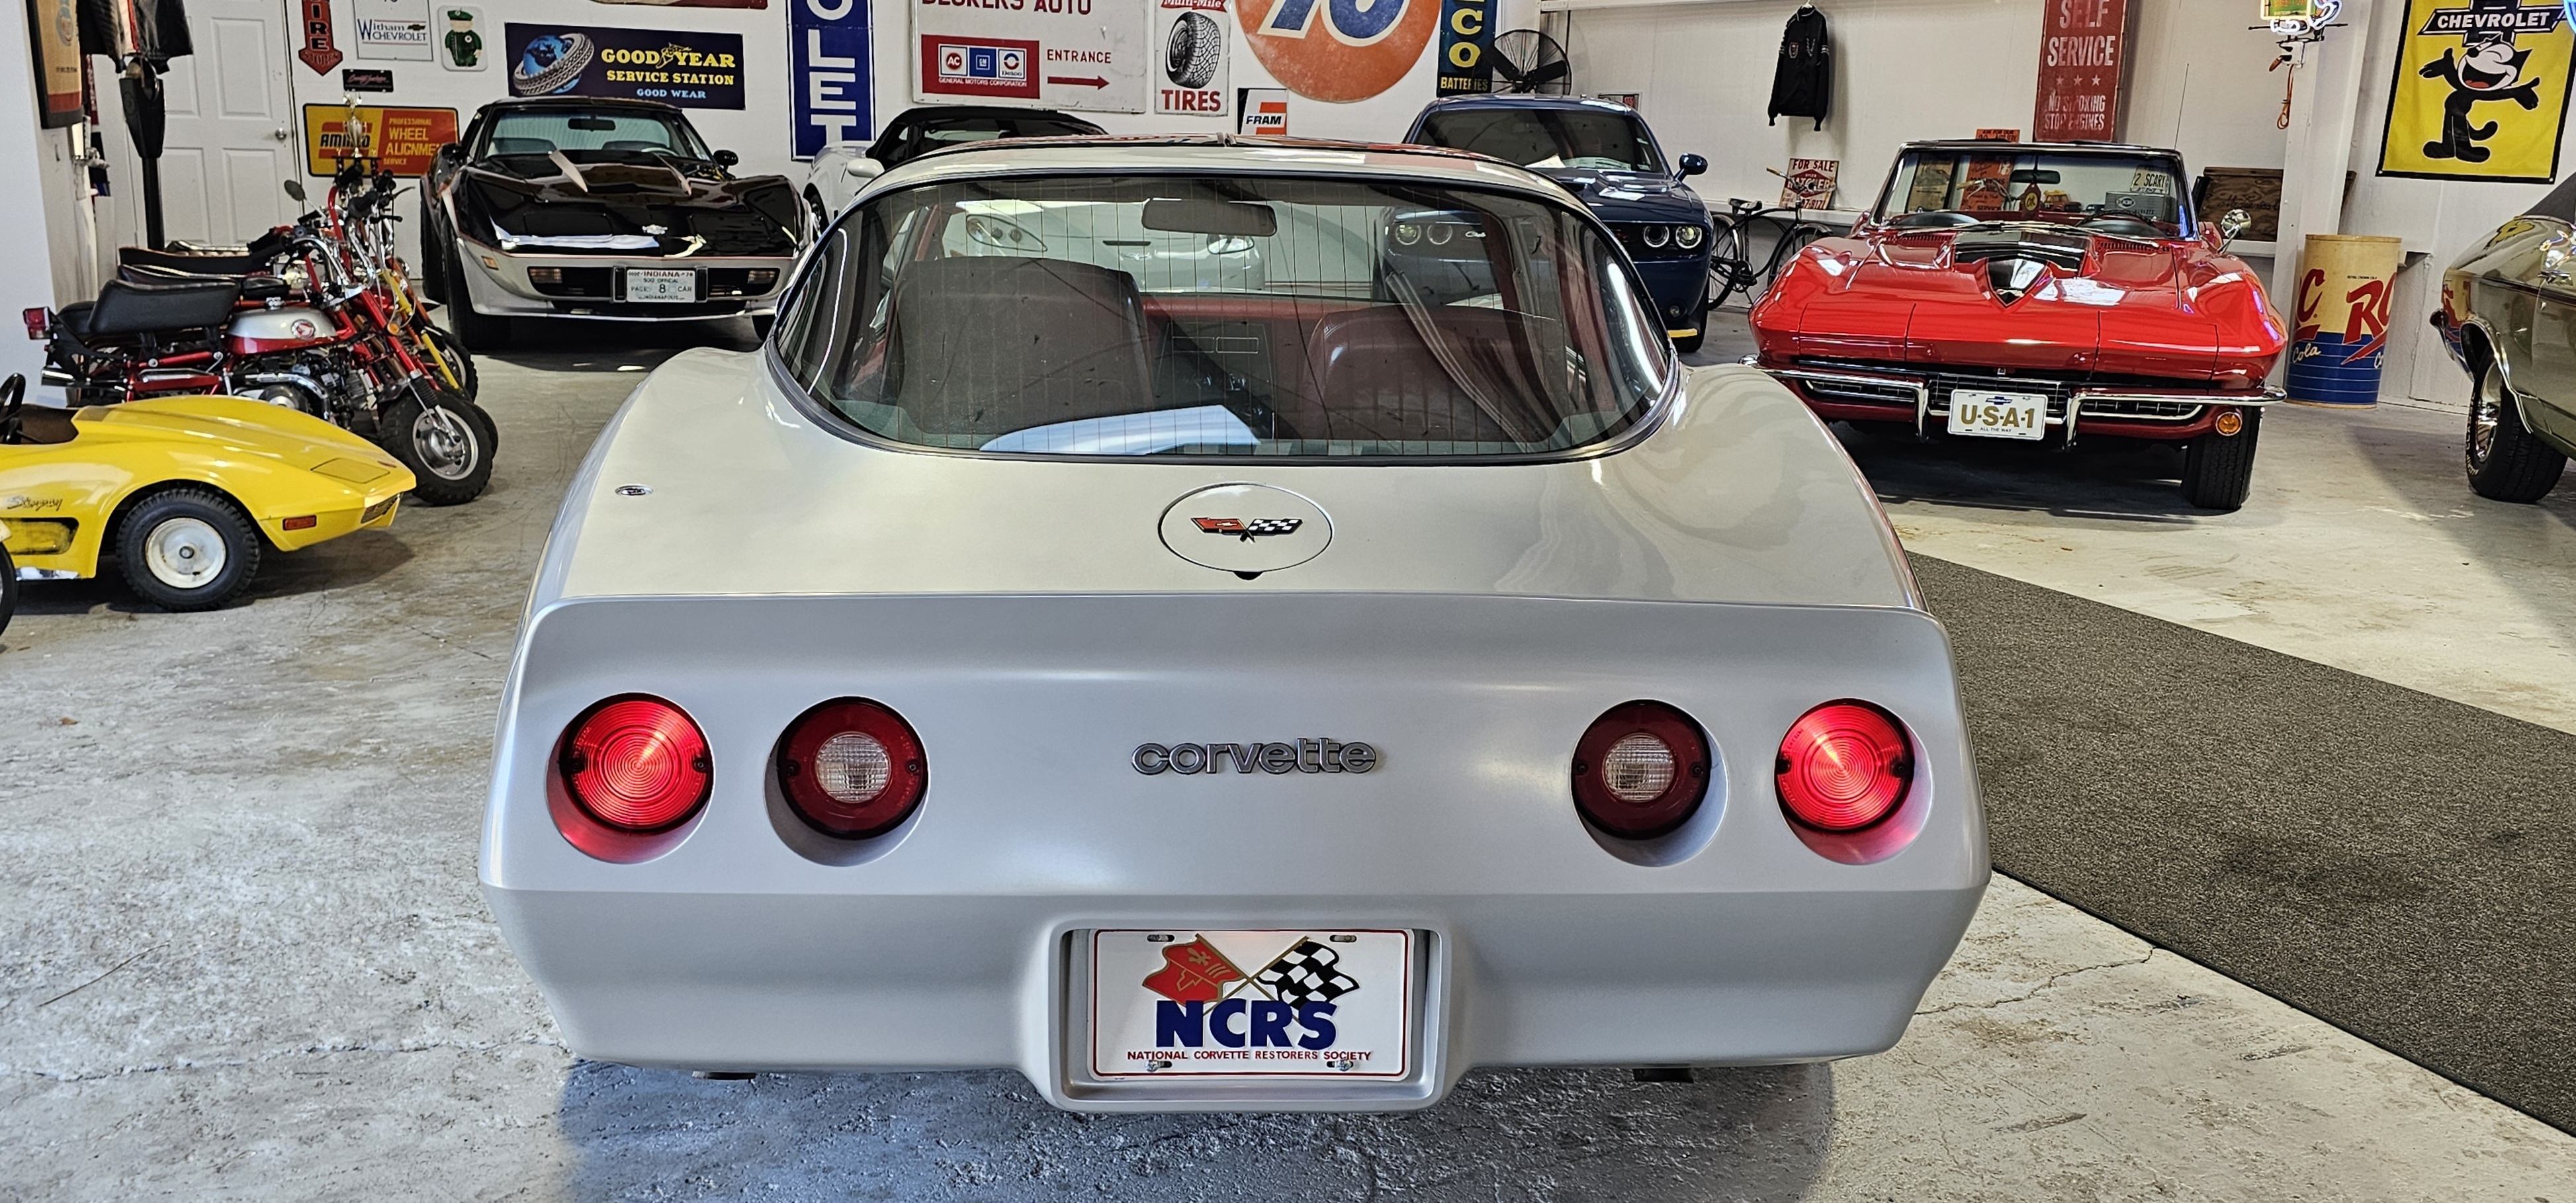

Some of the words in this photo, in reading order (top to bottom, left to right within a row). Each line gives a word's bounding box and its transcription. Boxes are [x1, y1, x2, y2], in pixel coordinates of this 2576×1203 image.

[2059, 0, 2110, 28] SELF
[2437, 12, 2550, 28] CHEVROLET
[308, 0, 330, 51] IRE
[372, 32, 427, 41] CHEVROLET
[1448, 0, 1483, 67] CO
[1047, 49, 1112, 64] ENTRANCE
[2047, 35, 2116, 66] SERVICE
[948, 56, 960, 66] AC
[607, 70, 669, 83] SERVICE
[673, 73, 734, 85] STATION
[671, 90, 706, 99] WEAR
[1161, 90, 1221, 112] TIRES
[1246, 116, 1282, 125] FRAM
[320, 134, 371, 148] AMO
[389, 128, 429, 141] WHEEL
[386, 142, 439, 156] ALIGNME
[1793, 159, 1809, 169] FOR
[1812, 161, 1834, 171] SALE
[2133, 173, 2141, 186] 2
[2144, 173, 2166, 188] SCARY
[658, 283, 666, 293] 8
[2292, 343, 2321, 363] Cola
[1132, 737, 1377, 775] corvette
[1156, 998, 1337, 1050] NCRS
[1127, 1051, 1188, 1060] NATIONAL
[1194, 1051, 1249, 1059] CORVETTE
[1255, 1051, 1318, 1060] RESTORERS
[1323, 1051, 1371, 1061] SOCIETY
